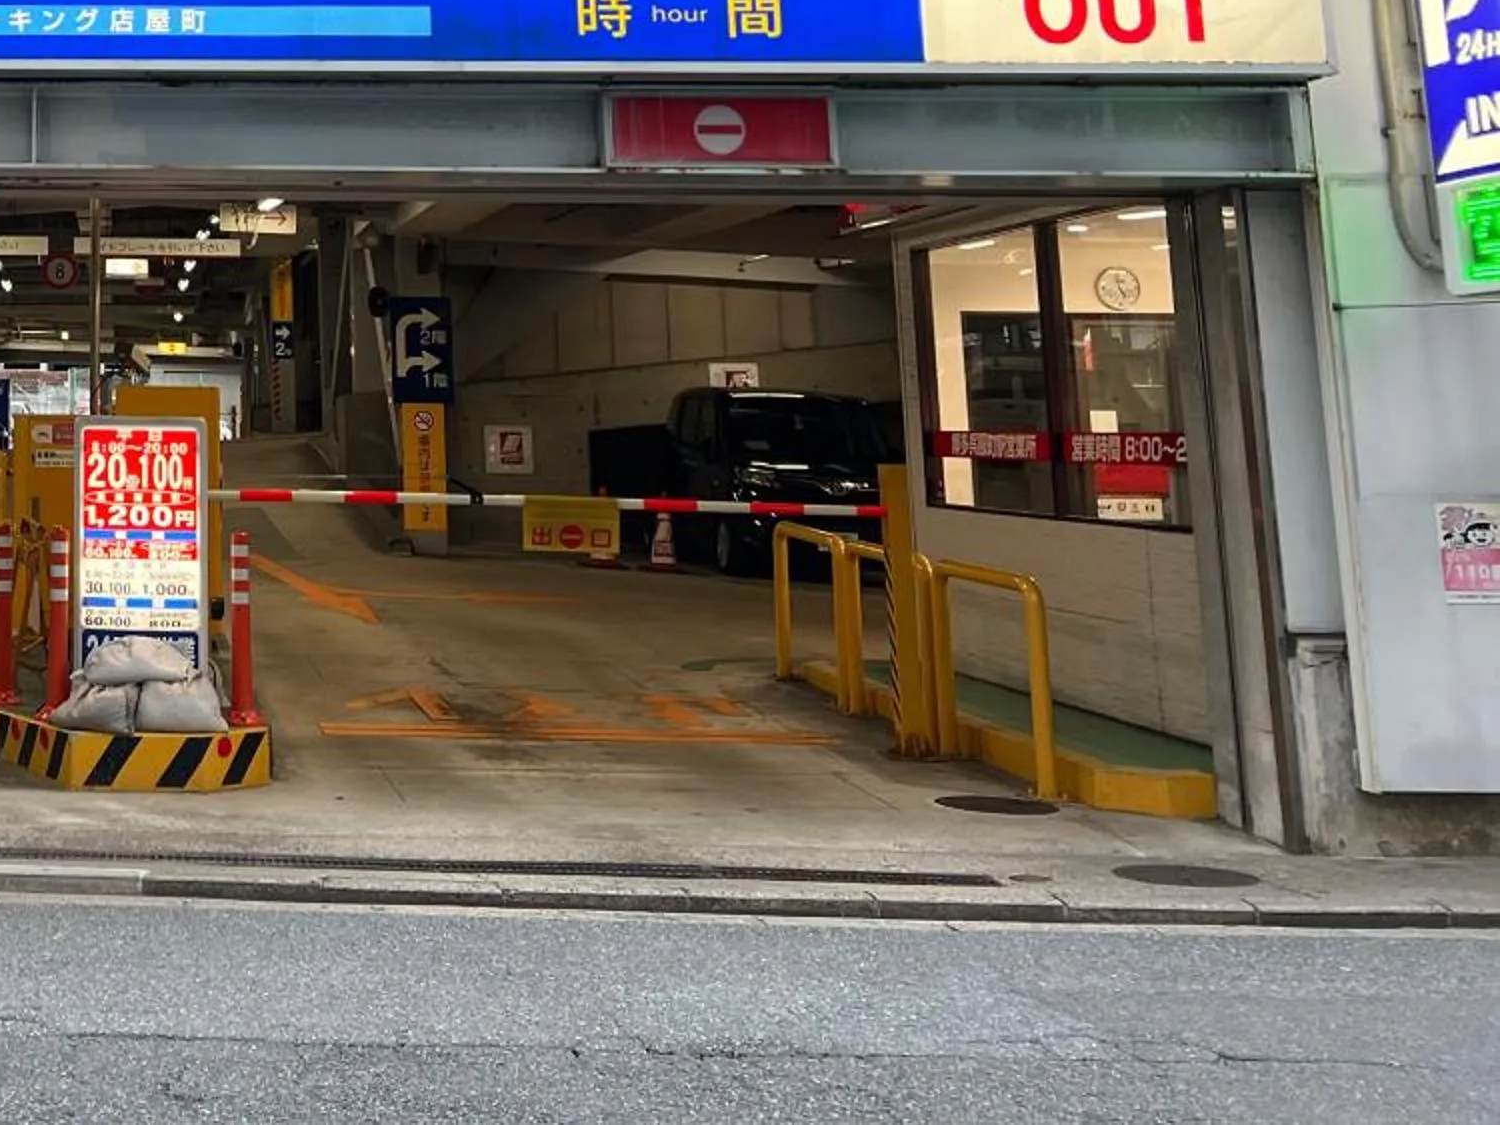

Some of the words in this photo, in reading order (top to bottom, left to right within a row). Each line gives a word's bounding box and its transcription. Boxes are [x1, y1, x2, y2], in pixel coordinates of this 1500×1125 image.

[651, 5, 708, 26] hour
[92, 241, 228, 254] イドブレーキを引いて下さい
[1071, 433, 1121, 463] 営業時間
[84, 504, 195, 527] 1,200円
[85, 580, 140, 595] 30100
[85, 615, 140, 628] 60100
